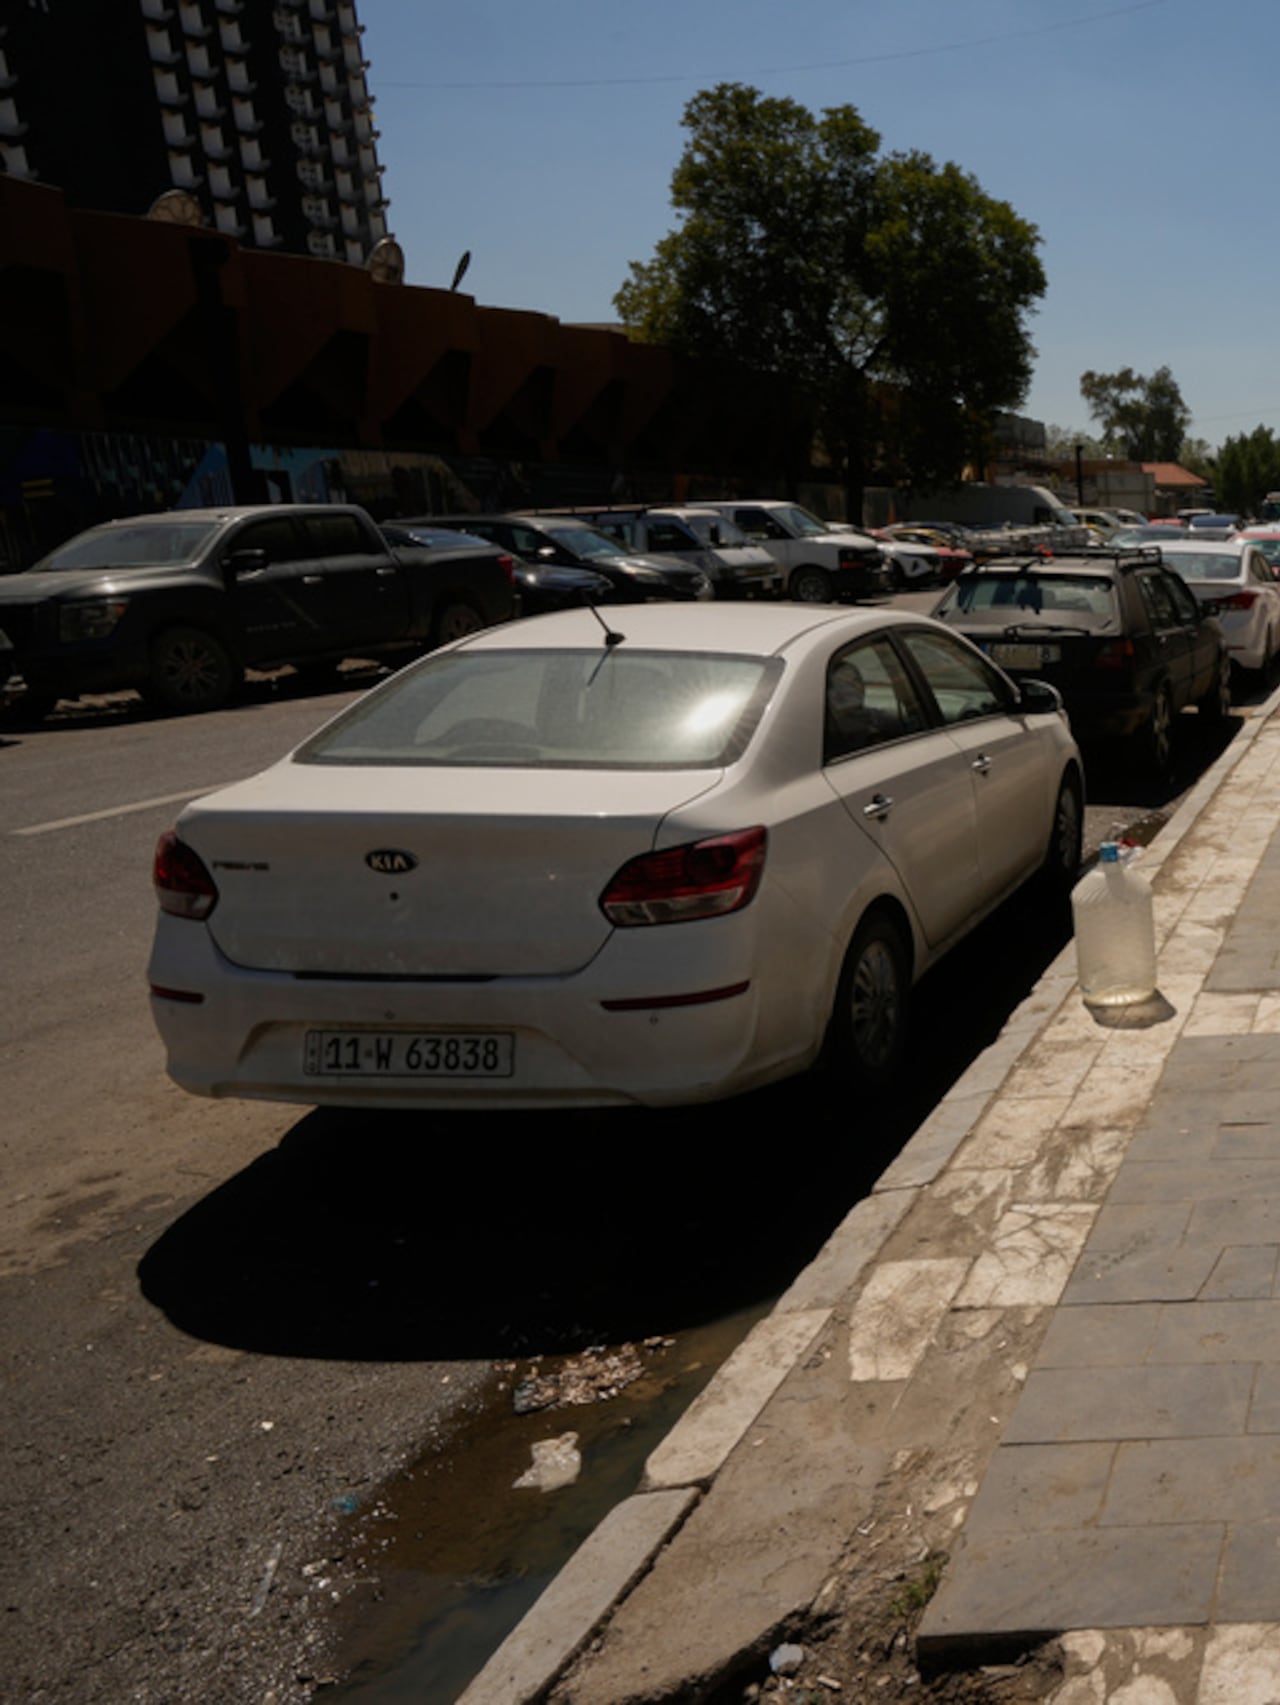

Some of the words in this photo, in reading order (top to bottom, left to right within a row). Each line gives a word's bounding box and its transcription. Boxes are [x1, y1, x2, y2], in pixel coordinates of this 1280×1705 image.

[370, 855, 407, 871] KIA
[326, 1036, 361, 1070] 11
[374, 1036, 393, 1071] W
[405, 1037, 499, 1071] 63838
